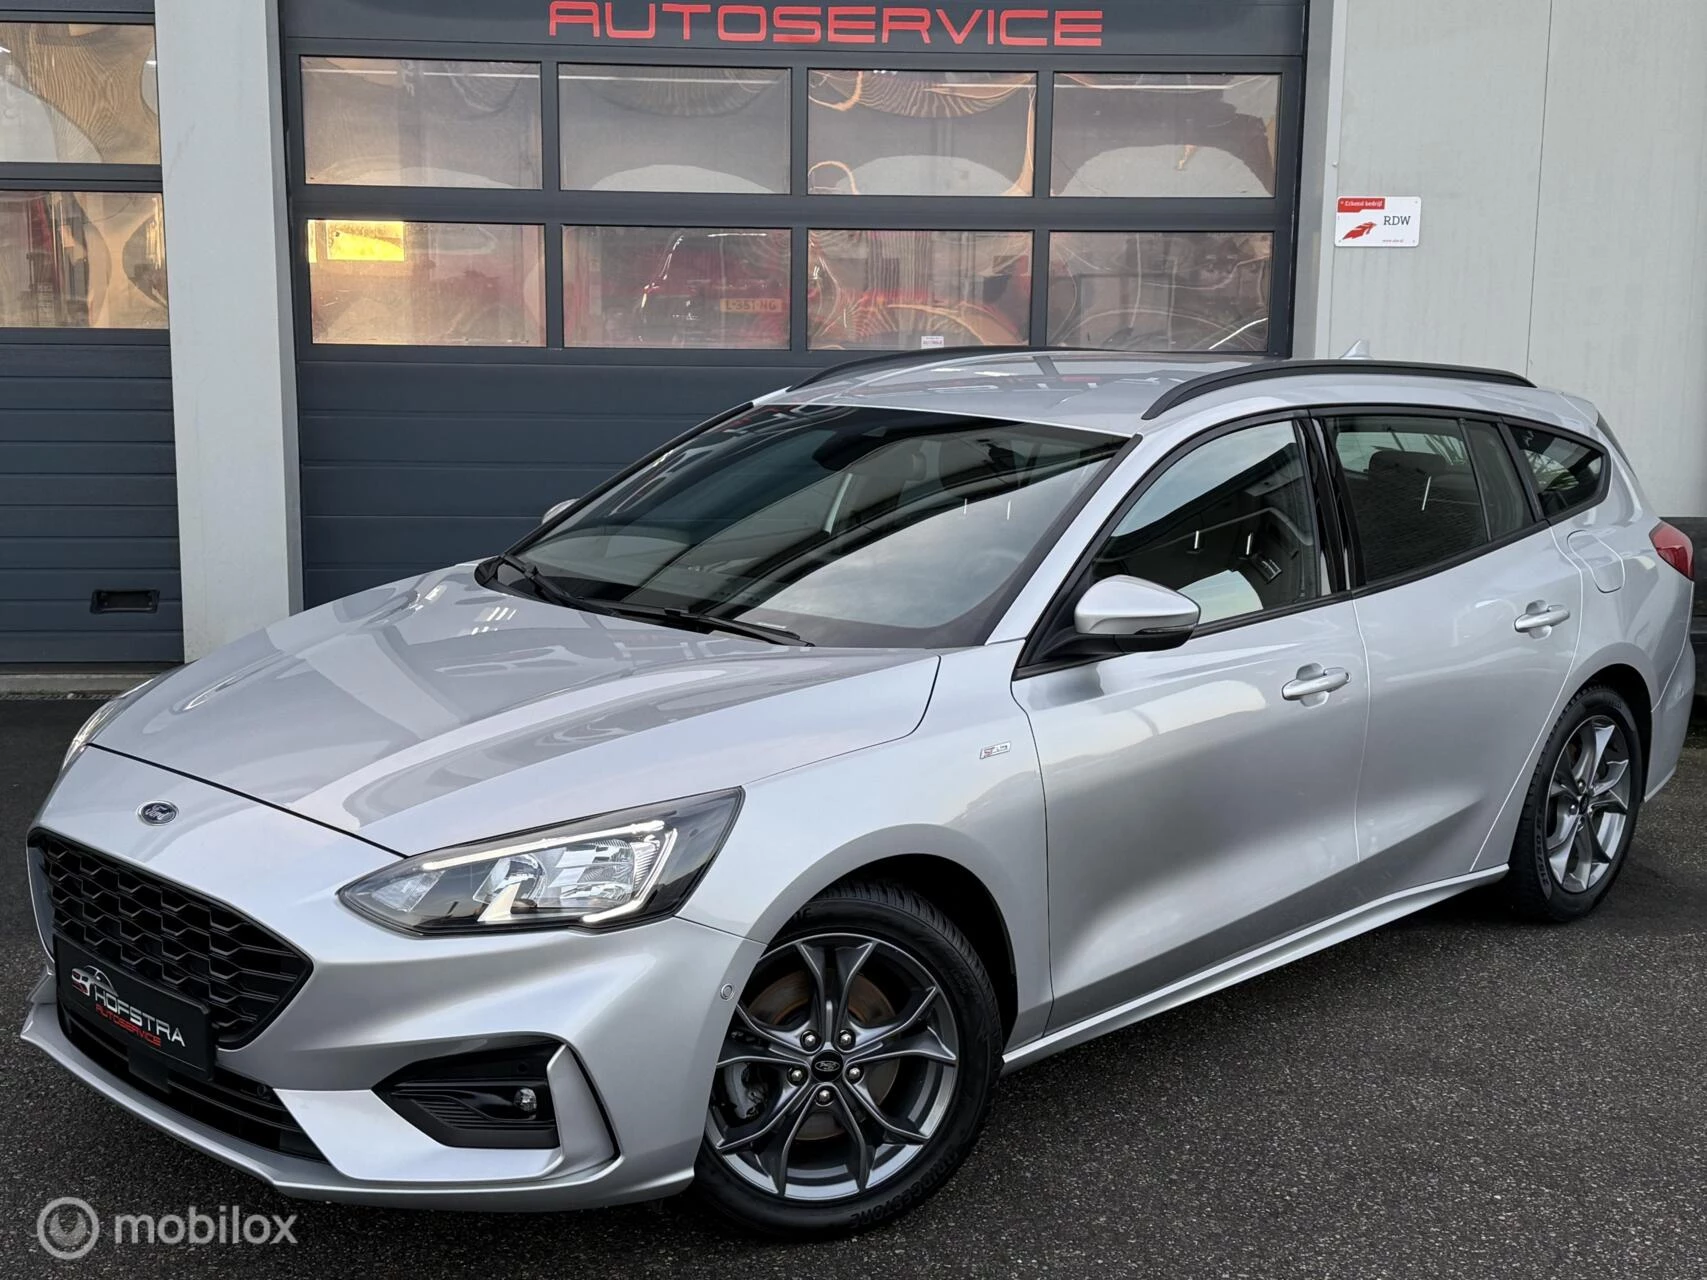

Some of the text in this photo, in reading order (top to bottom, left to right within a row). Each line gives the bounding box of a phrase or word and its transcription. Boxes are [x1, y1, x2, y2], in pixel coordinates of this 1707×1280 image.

[549, 1, 1103, 46] AUTOSERVICE
[1383, 215, 1411, 226] RDW
[95, 983, 186, 1047] HOFSTRA
[95, 1003, 162, 1048] AUTOSERVICE
